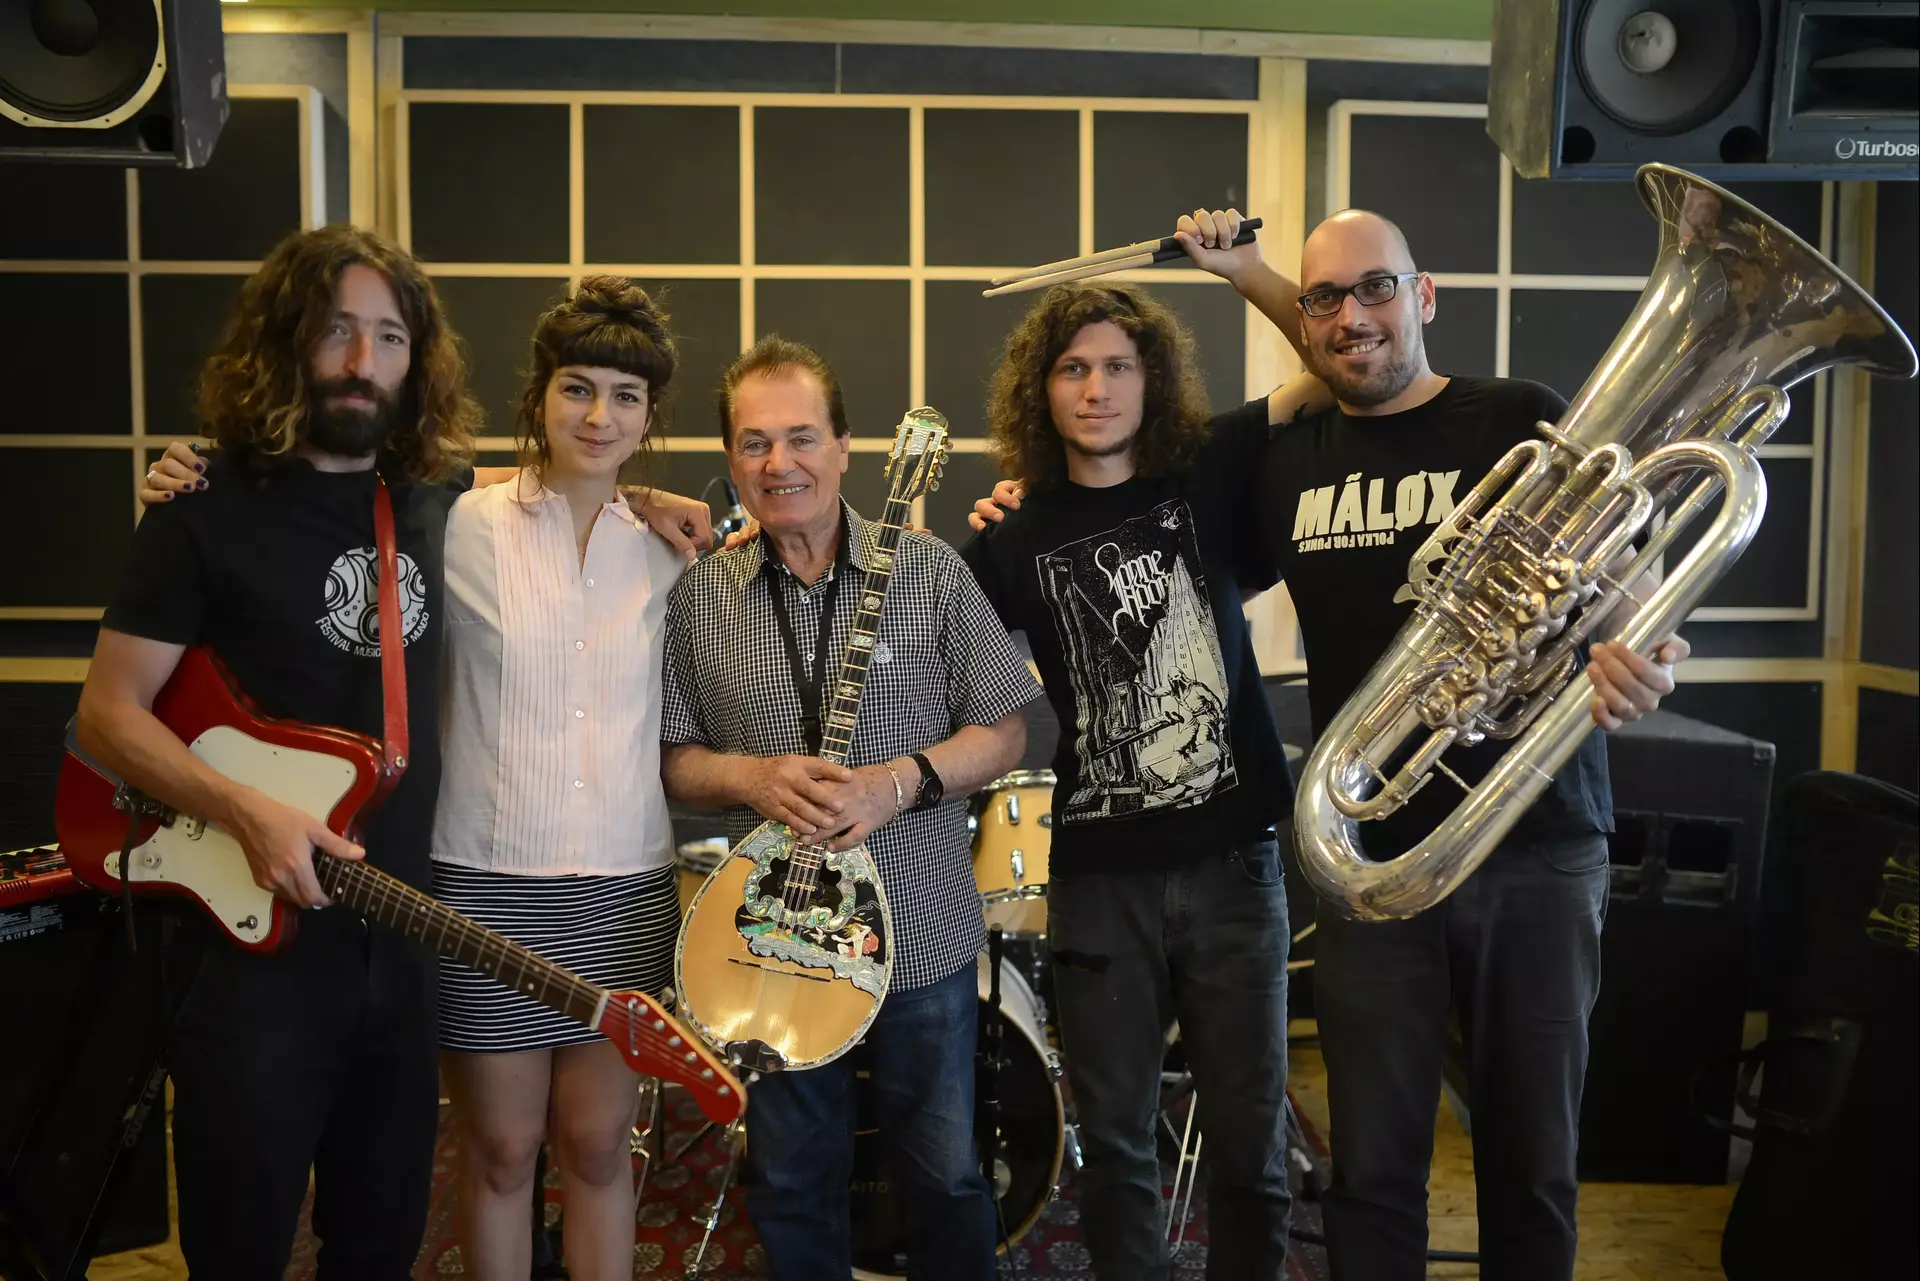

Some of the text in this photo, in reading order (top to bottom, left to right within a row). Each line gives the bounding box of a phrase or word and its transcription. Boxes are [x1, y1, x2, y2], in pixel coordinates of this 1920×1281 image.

[1857, 140, 1919, 157] Turbos
[1298, 530, 1395, 554] POLKA FOR PUNKS
[315, 616, 351, 652] FESTIVAL
[353, 644, 382, 658] MÚSIC
[410, 612, 430, 642] MUNDO
